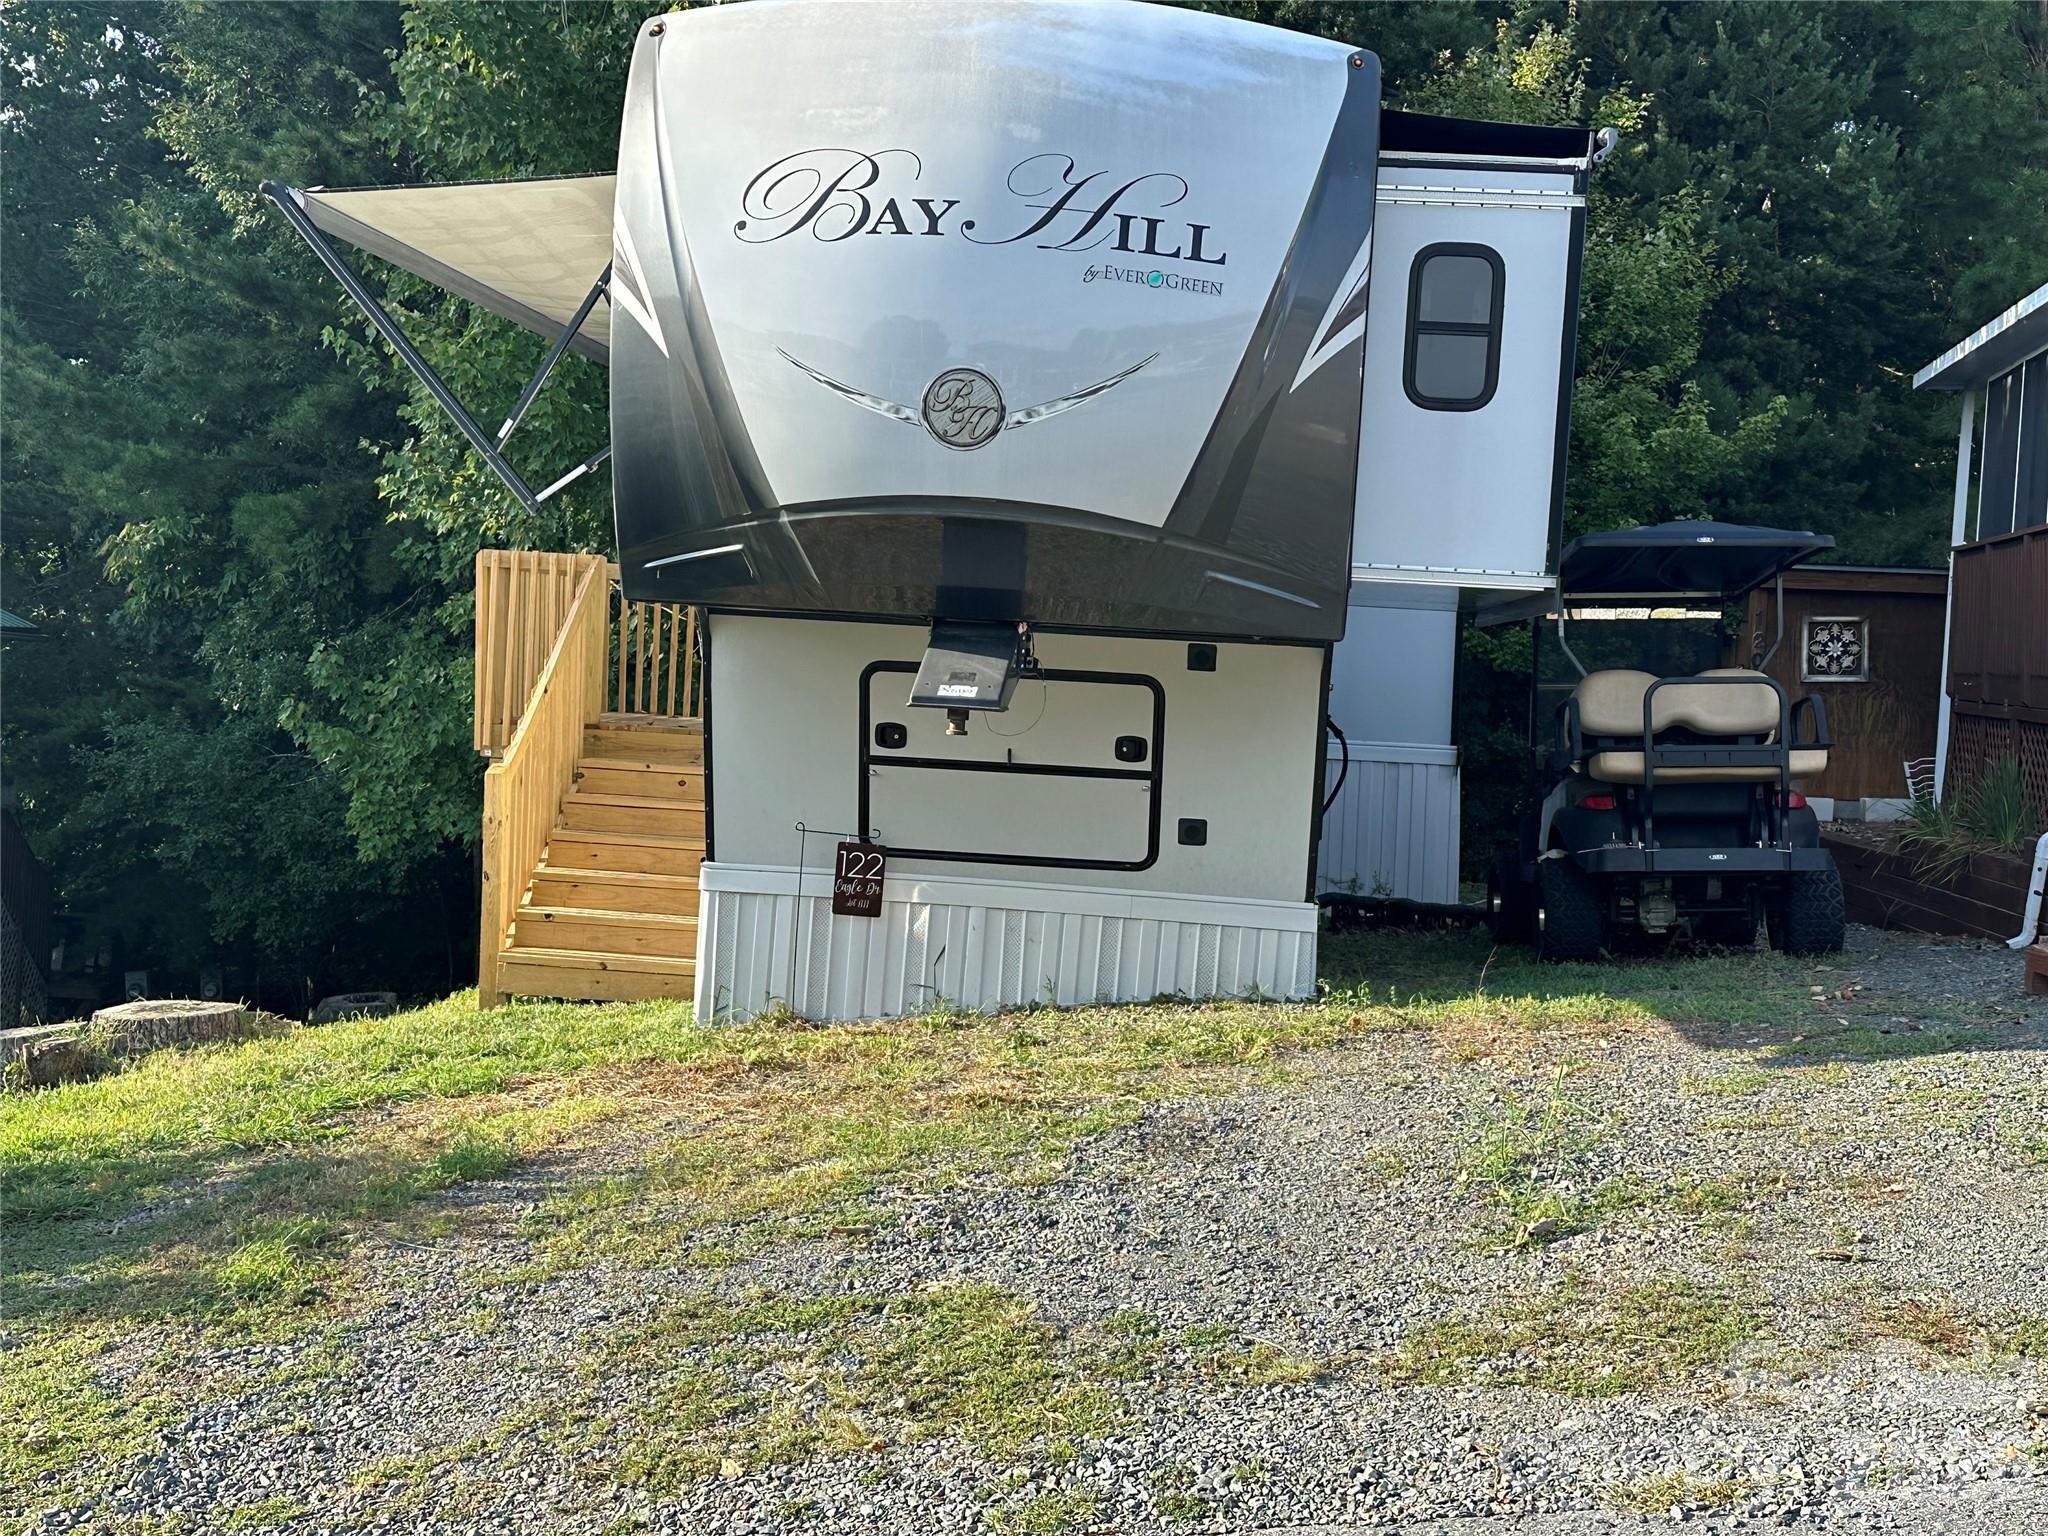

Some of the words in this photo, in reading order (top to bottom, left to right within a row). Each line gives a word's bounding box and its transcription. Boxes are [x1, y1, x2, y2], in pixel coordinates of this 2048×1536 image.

[734, 148, 961, 244] BAY
[961, 153, 1227, 265] HILL
[840, 850, 884, 880] 122
[834, 878, 863, 896] Eagle
